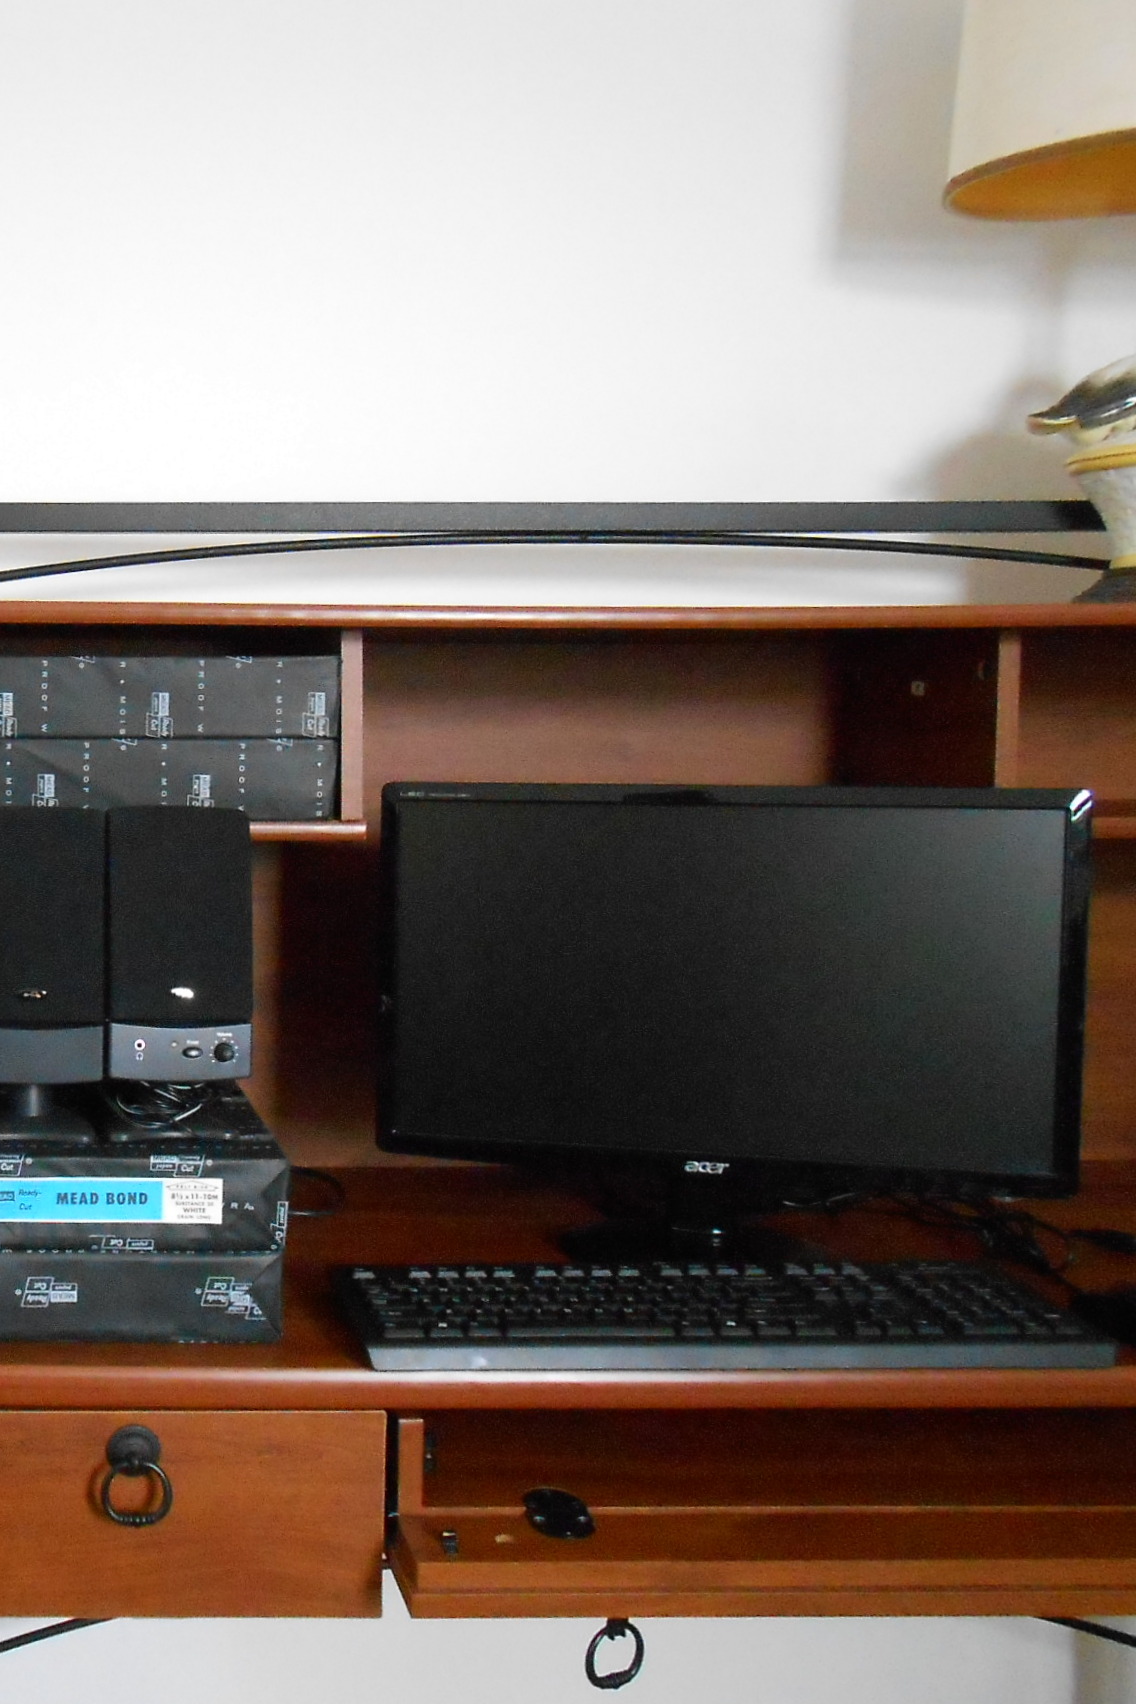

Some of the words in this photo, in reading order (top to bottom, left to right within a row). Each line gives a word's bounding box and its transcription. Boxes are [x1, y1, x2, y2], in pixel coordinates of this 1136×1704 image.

[684, 1161, 730, 1174] acer
[56, 1192, 99, 1205] MEAD
[105, 1192, 148, 1205] BOND
